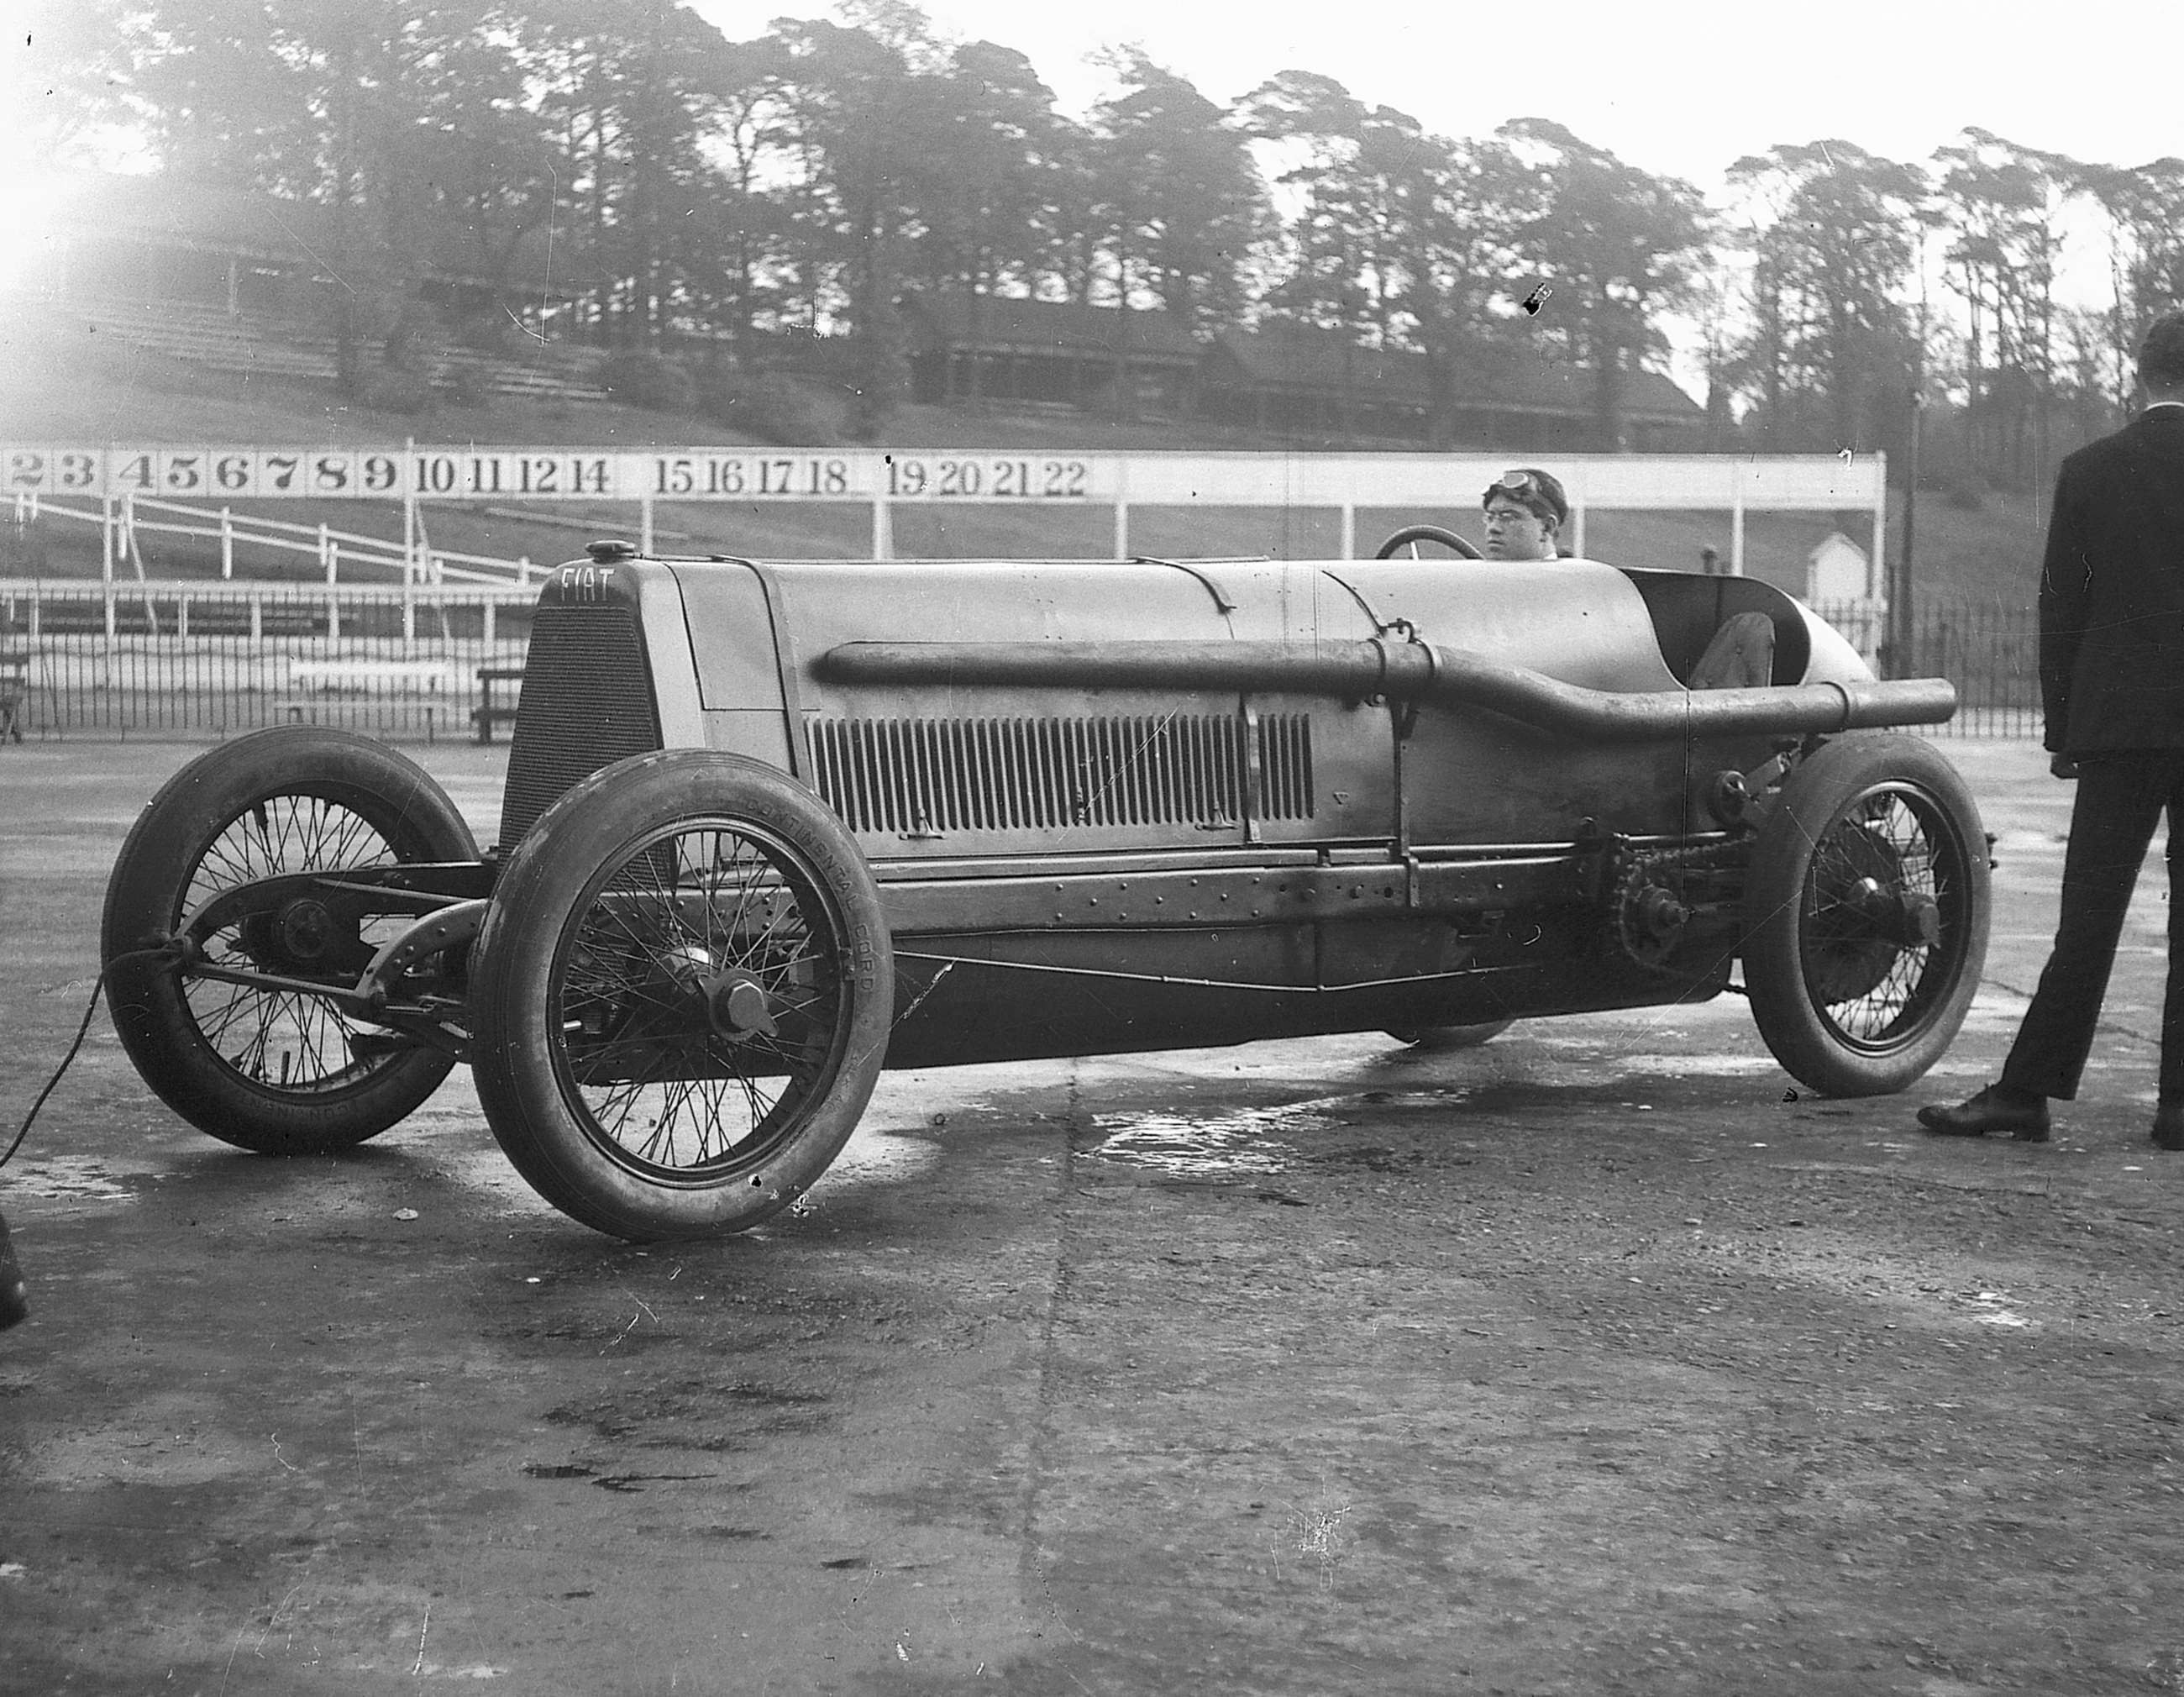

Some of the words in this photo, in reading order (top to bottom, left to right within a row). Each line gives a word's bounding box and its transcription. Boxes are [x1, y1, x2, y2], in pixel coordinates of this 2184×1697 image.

[11, 454, 44, 486] 2
[62, 454, 94, 487] 3
[118, 455, 154, 488] 4
[168, 456, 200, 489] 5
[216, 457, 249, 489] 6
[266, 457, 298, 490] 7
[316, 457, 348, 490] 8
[365, 457, 397, 490] 9
[417, 459, 455, 492] 10
[471, 459, 501, 492] 11
[517, 460, 558, 493] 12
[571, 460, 608, 493] 14
[655, 460, 694, 494] 15
[706, 460, 744, 494] 16
[757, 460, 794, 495] 17
[808, 460, 848, 495] 18
[887, 461, 927, 496] 19
[940, 461, 981, 496] 20
[994, 461, 1030, 496] 21
[1044, 461, 1086, 496] 22
[560, 567, 616, 602] FIAT
[745, 800, 859, 912] CONTINENTAL
[855, 923, 874, 992] CORD
